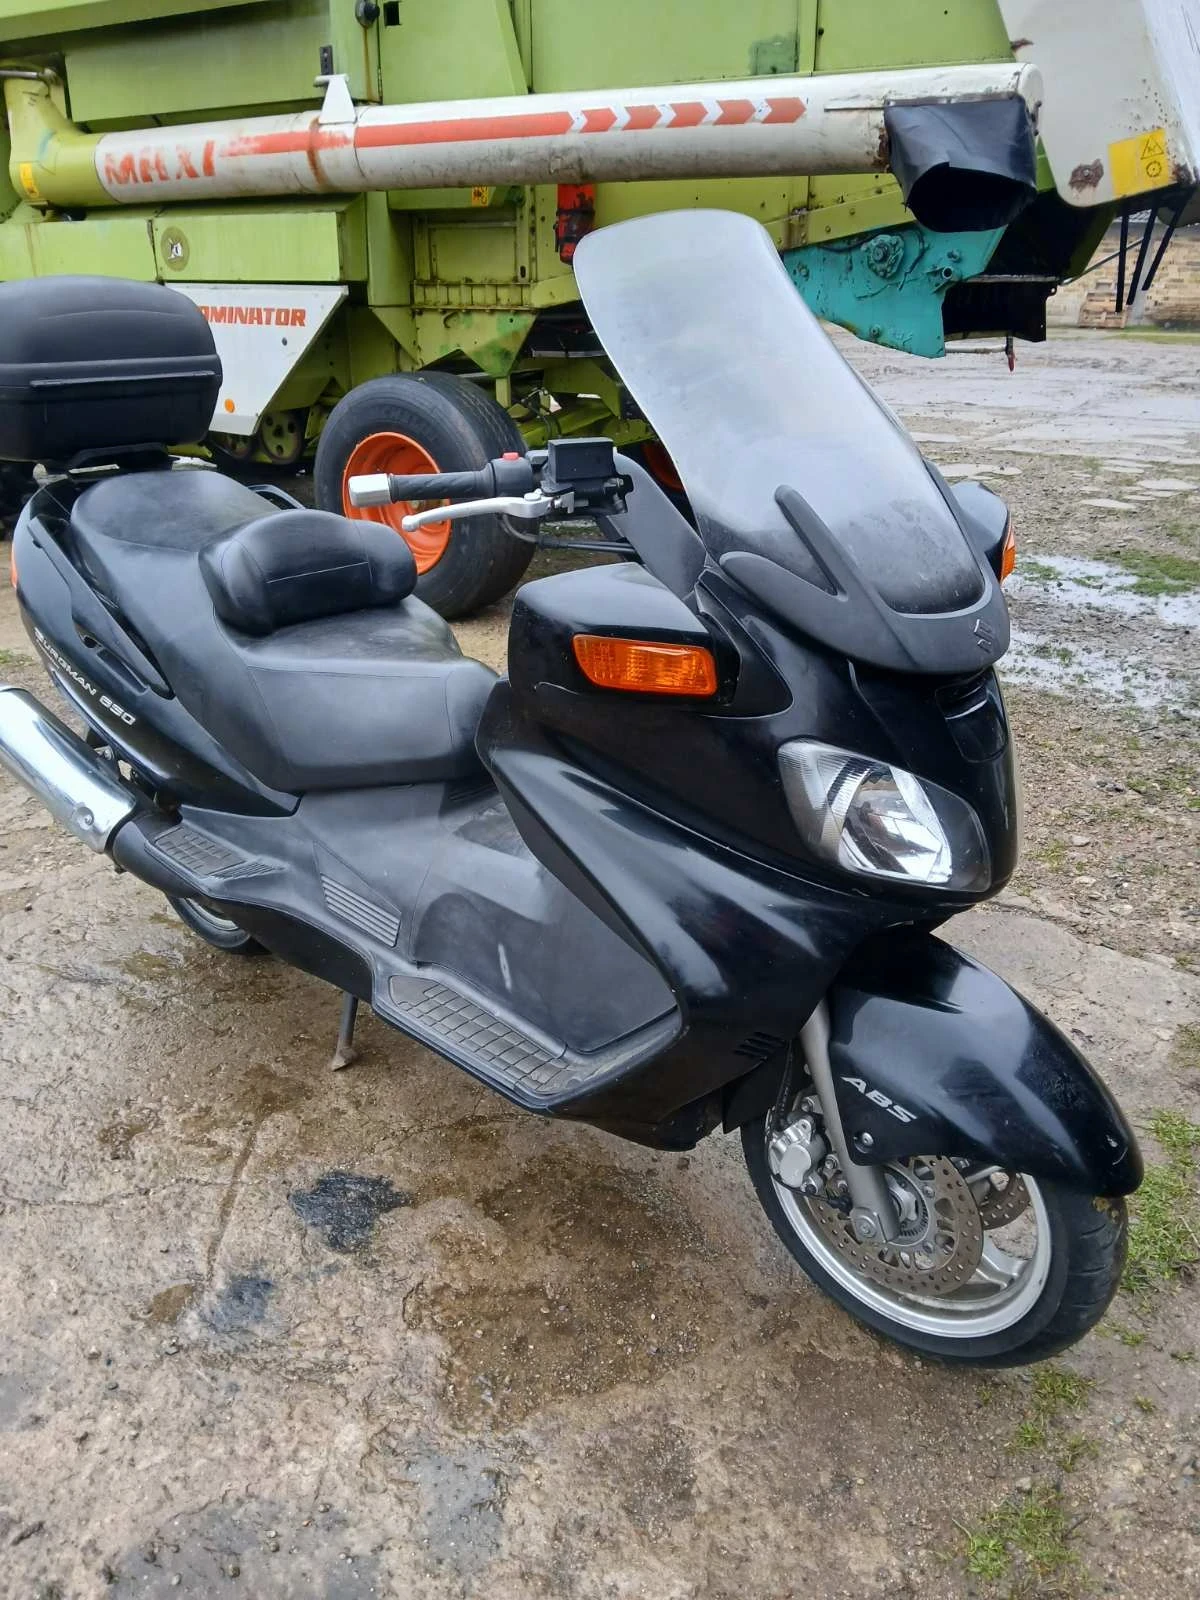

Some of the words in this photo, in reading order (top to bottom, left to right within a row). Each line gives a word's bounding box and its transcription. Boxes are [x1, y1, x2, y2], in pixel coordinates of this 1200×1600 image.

[197, 305, 306, 327] OMINATOR
[34, 627, 97, 695] BURGMAN
[99, 695, 136, 726] 650
[840, 1076, 917, 1123] ABS
